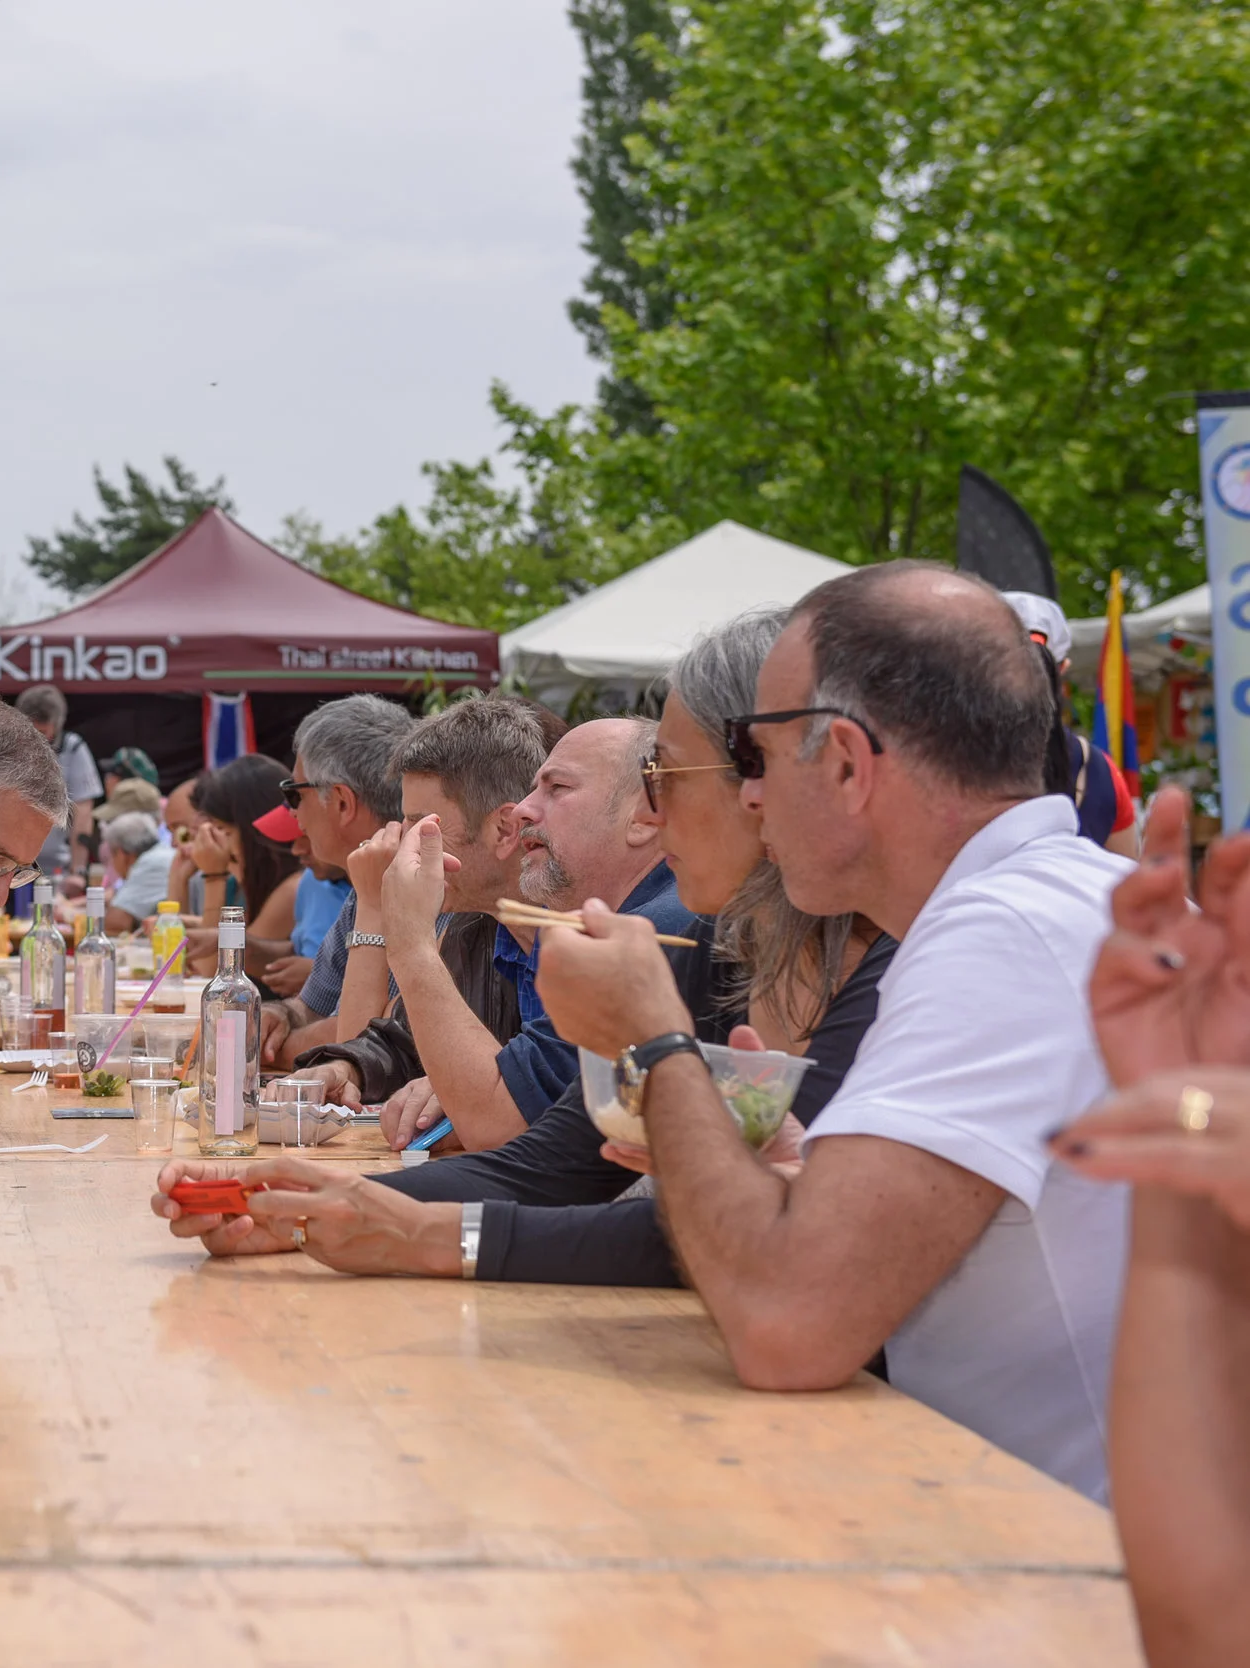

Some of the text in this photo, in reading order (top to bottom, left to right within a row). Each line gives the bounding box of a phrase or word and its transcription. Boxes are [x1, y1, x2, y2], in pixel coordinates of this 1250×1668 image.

[278, 645, 479, 669] Thai street Kitchen
